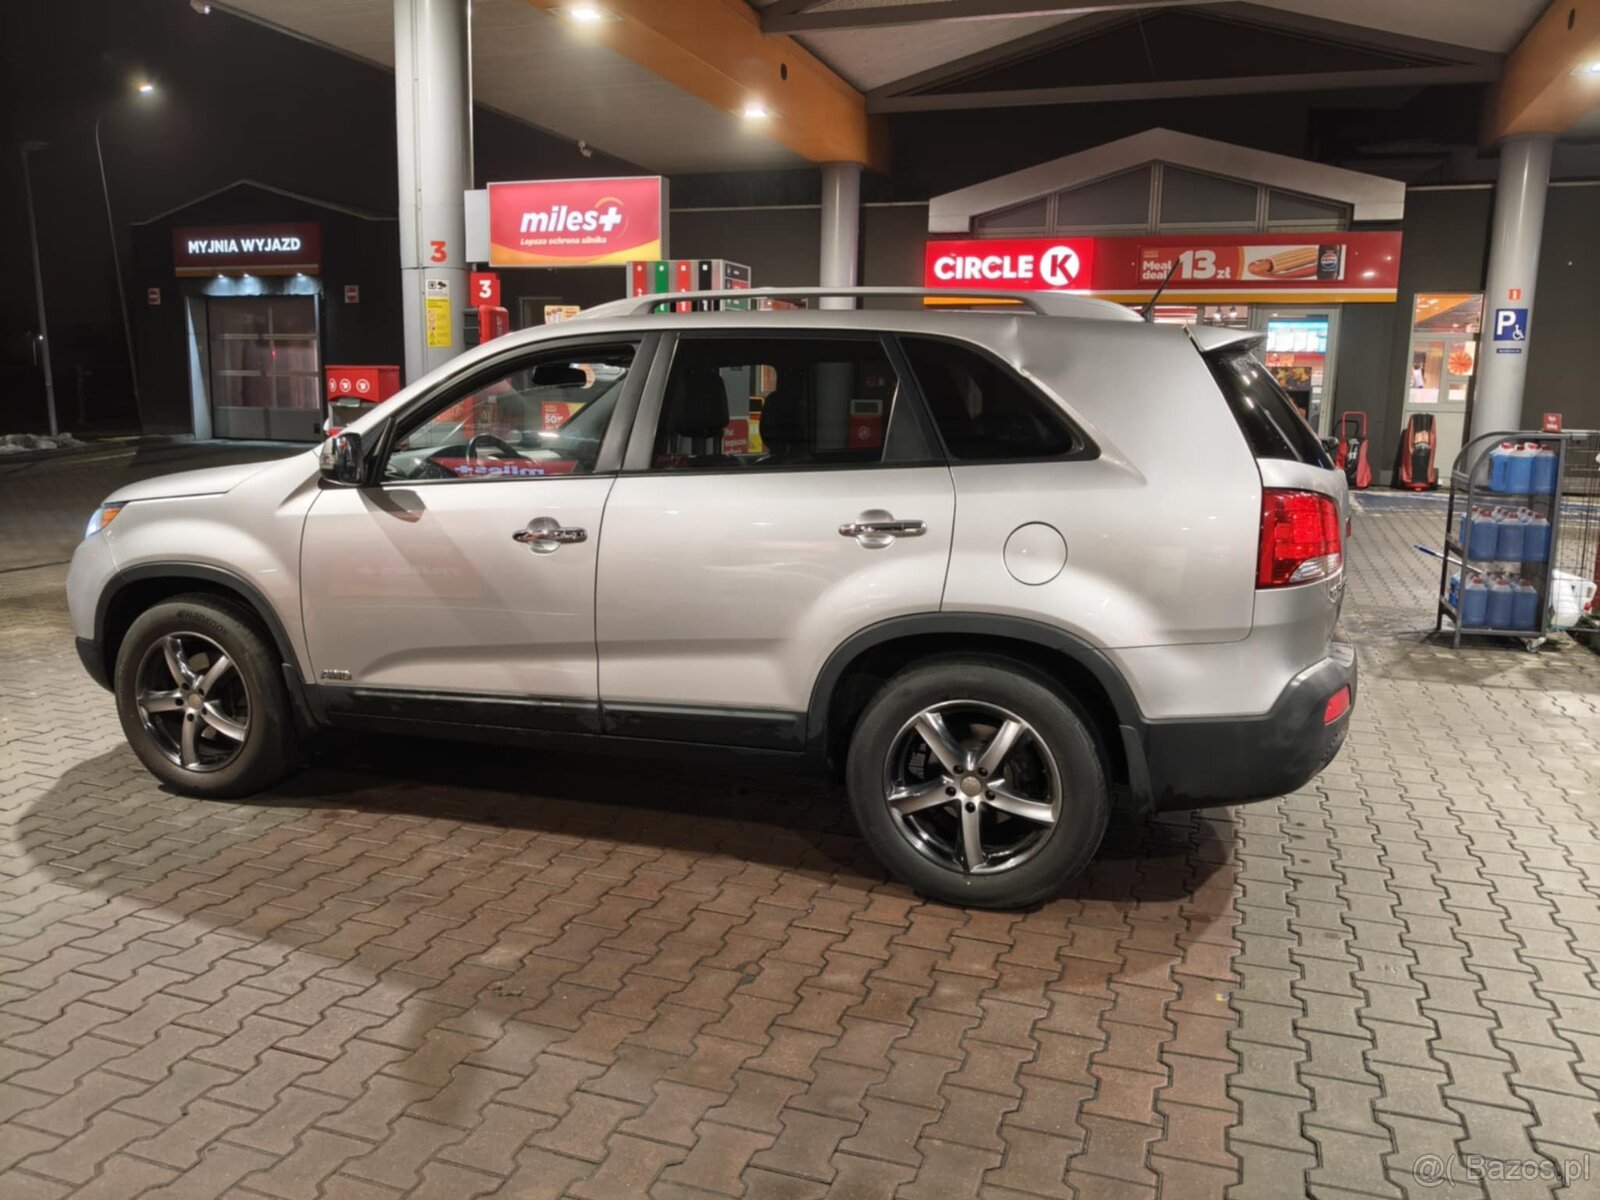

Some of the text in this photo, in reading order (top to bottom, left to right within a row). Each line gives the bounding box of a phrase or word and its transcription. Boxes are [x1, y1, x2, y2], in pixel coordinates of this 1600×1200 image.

[520, 205, 622, 232] miles+
[188, 237, 301, 254] MYJNIA WYJAZD
[430, 240, 448, 263] 3
[933, 250, 1078, 286] CIRCLE K
[1142, 260, 1172, 271] Meal
[1179, 249, 1217, 280] 13
[479, 279, 493, 299] 3
[1496, 310, 1517, 336] P
